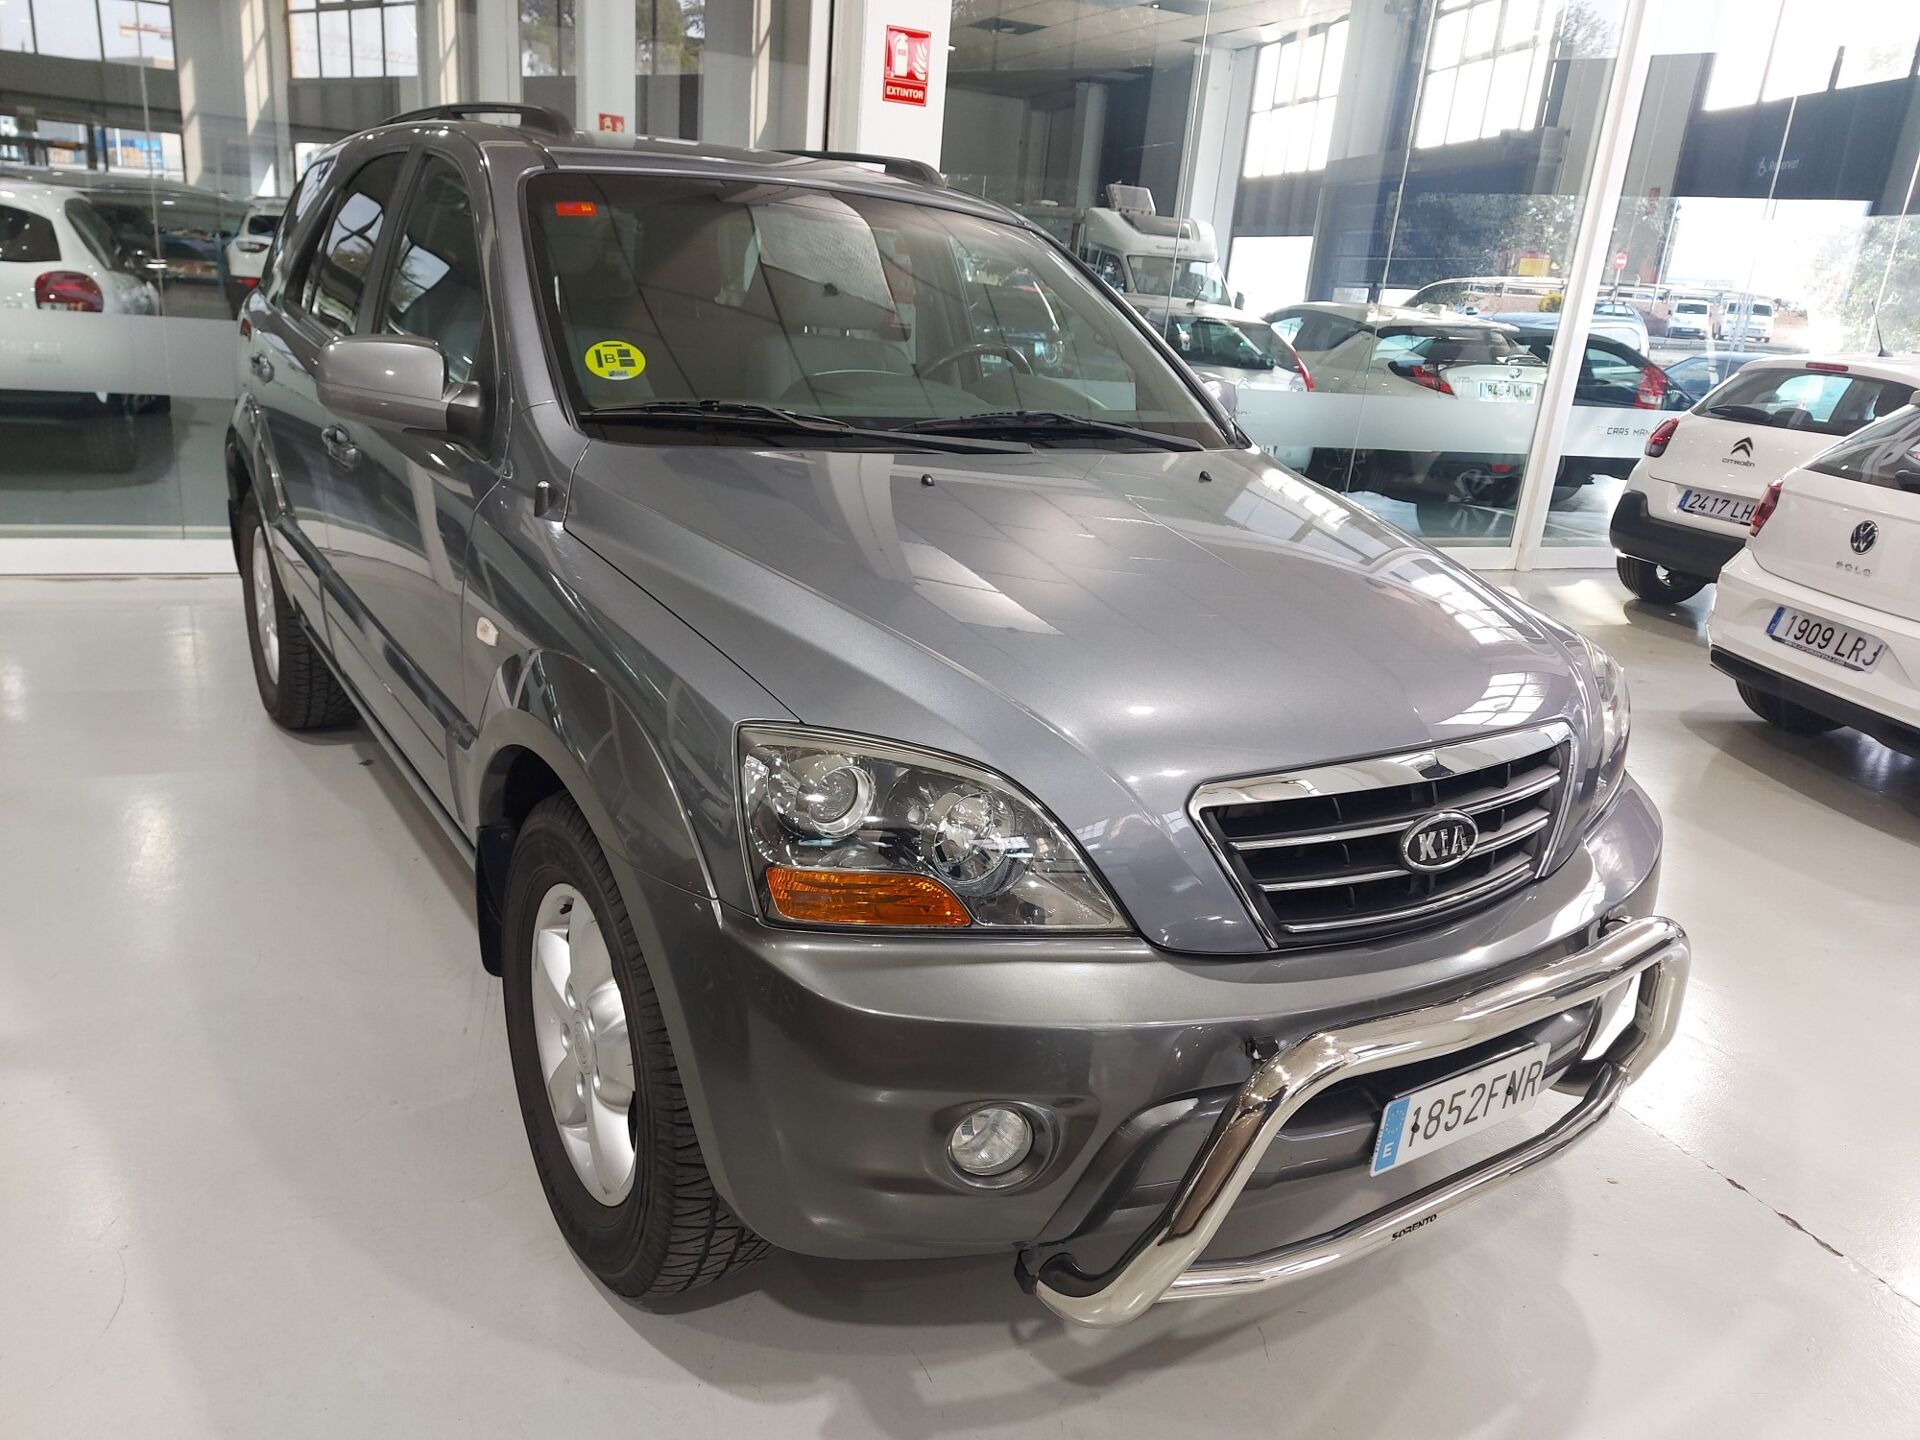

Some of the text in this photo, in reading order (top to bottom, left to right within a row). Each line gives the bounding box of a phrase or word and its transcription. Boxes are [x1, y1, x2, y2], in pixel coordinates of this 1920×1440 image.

[886, 85, 924, 100] EXTINTOR
[604, 353, 617, 364] B
[1606, 426, 1630, 436] CARS
[1688, 493, 1731, 515] 2417
[1729, 501, 1756, 521] LH
[1835, 560, 1872, 577] POLO
[1784, 614, 1835, 650] 1909
[1833, 631, 1884, 666] LRJ
[1417, 824, 1468, 862] KIA
[1382, 1141, 1395, 1159] E
[1391, 1213, 1438, 1242] SORENTO
